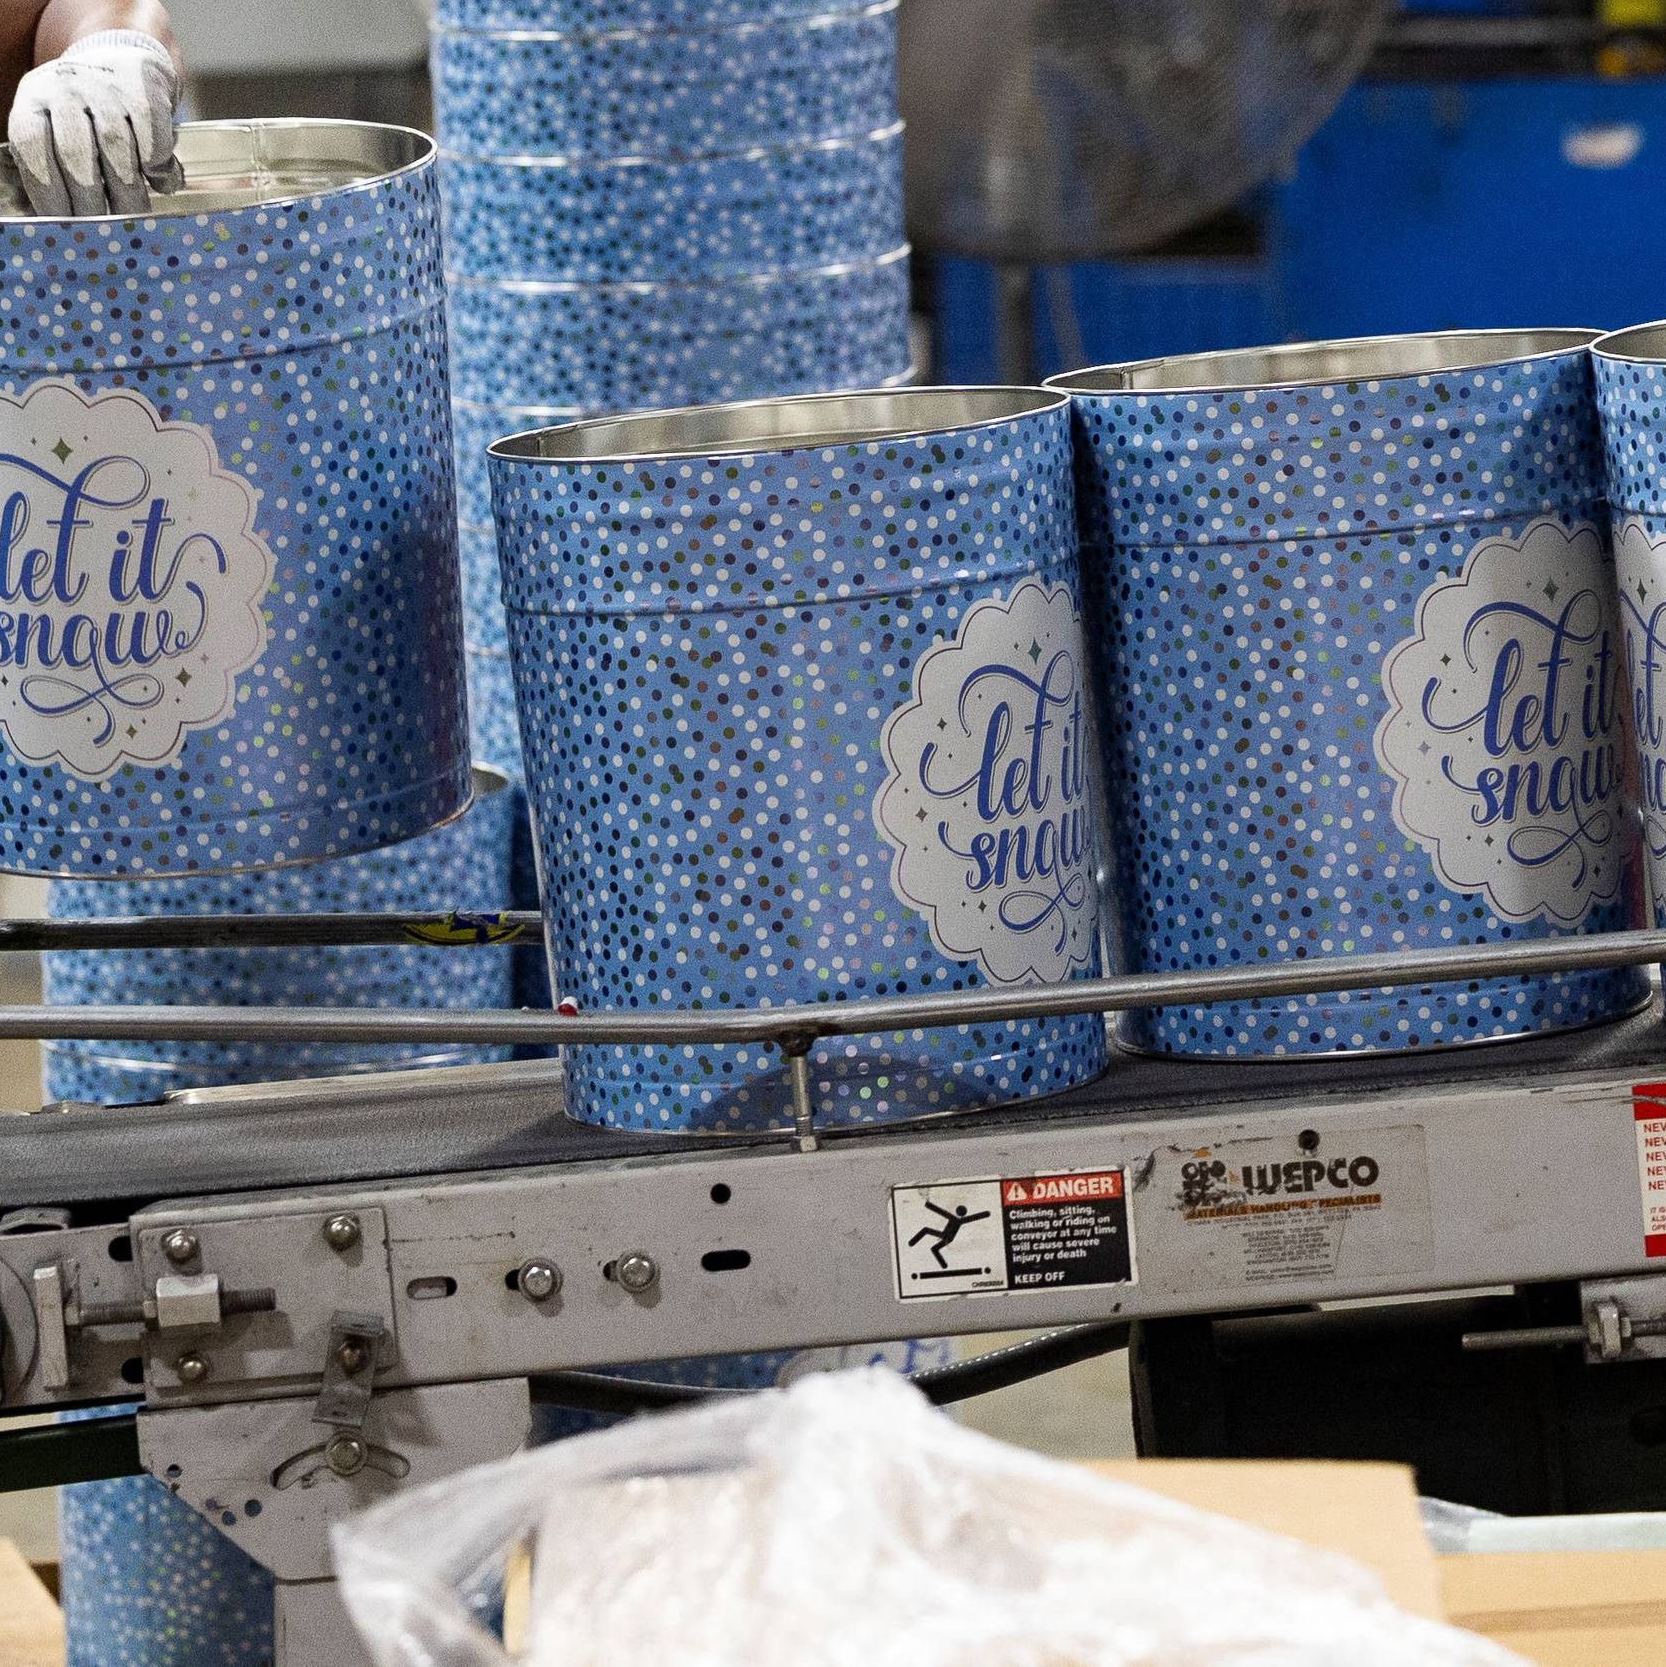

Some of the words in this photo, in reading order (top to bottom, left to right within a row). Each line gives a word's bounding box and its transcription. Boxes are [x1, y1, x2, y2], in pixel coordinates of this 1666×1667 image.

[109, 497, 227, 602] it
[1423, 590, 1602, 755] let
[1583, 630, 1615, 740] it
[920, 650, 1073, 822] let
[1061, 691, 1088, 802] it
[1240, 1154, 1380, 1196] WEPCO
[1031, 1175, 1114, 1199] DANGER
[1009, 1206, 1057, 1220] Climbing,
[1010, 1219, 1050, 1232] walking
[1052, 1219, 1062, 1227] or
[1065, 1215, 1095, 1227] riding
[1097, 1215, 1110, 1223] on
[1010, 1230, 1058, 1242] conveyor
[1059, 1228, 1070, 1237] at
[1073, 1228, 1091, 1238] any
[1093, 1224, 1117, 1234] time
[1011, 1241, 1030, 1251] will
[1032, 1240, 1063, 1250] cause
[1065, 1238, 1100, 1248] severe
[1012, 1252, 1041, 1264] injury
[1043, 1252, 1054, 1260] or
[1056, 1248, 1087, 1259] death
[1014, 1272, 1042, 1284] KEEP
[1044, 1270, 1065, 1281] OFF
